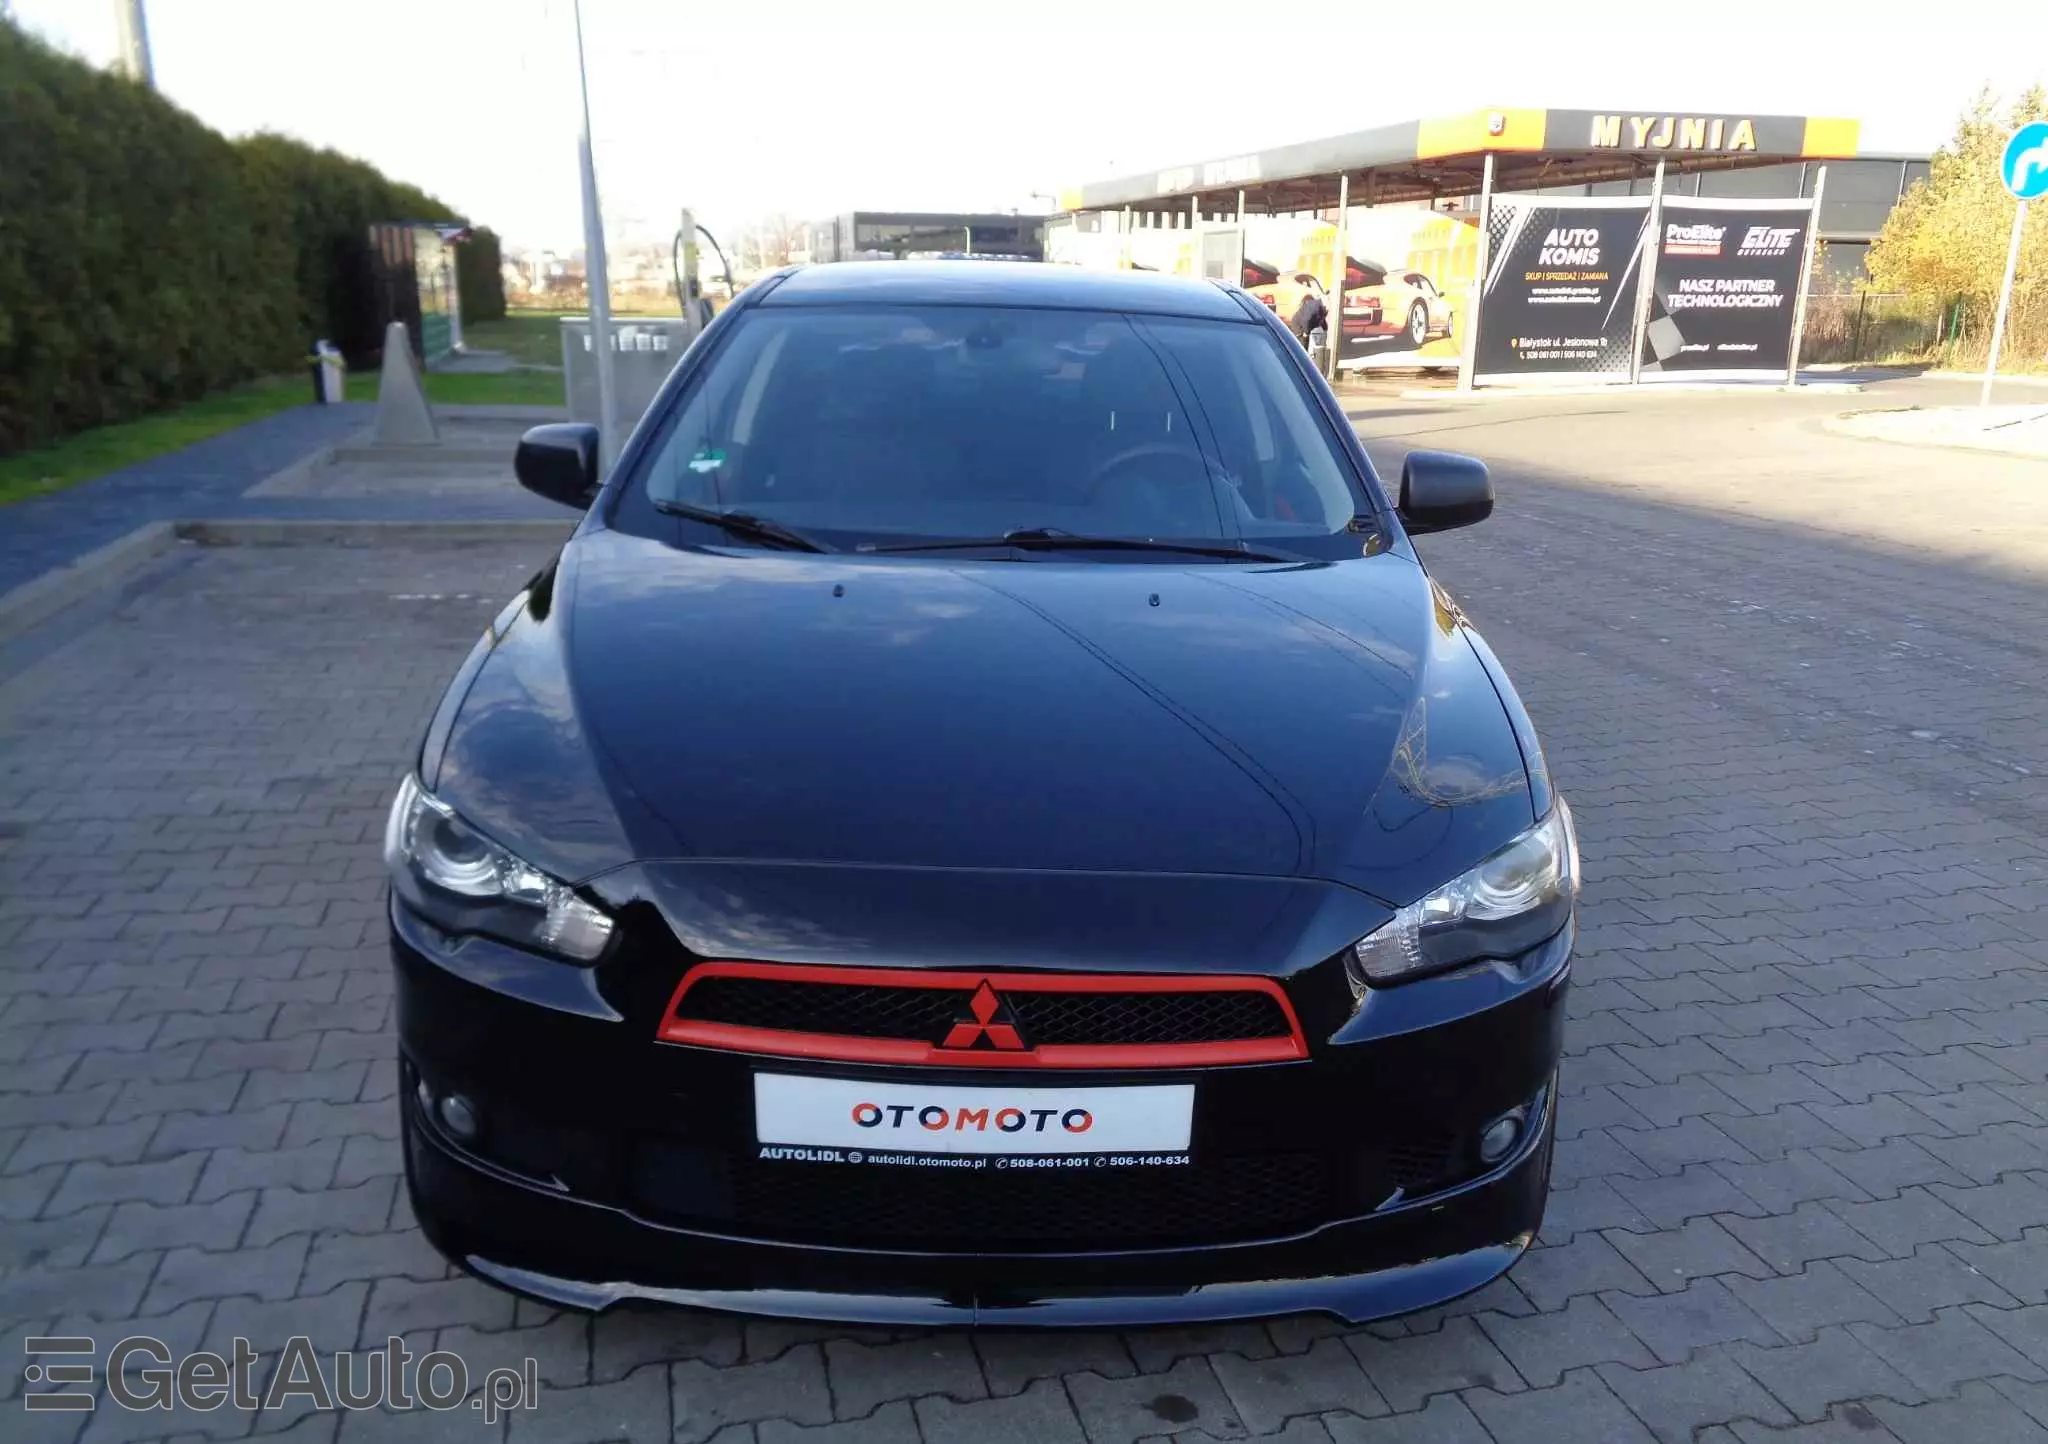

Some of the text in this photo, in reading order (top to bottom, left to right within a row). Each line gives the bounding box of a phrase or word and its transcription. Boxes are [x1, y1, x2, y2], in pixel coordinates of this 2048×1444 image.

[1591, 115, 1757, 150] MYJNIA
[1544, 228, 1599, 246] AUTO
[1539, 247, 1600, 265] KOMIS
[1680, 279, 1776, 293] NASZ PARTNER
[1667, 294, 1784, 308] TECHNOLOGICZNY
[851, 1102, 1093, 1133] OTOMOTO
[758, 1147, 1190, 1169] AUTOLIDL autolidl.otomoto.pl 508-061-001 506-140-634
